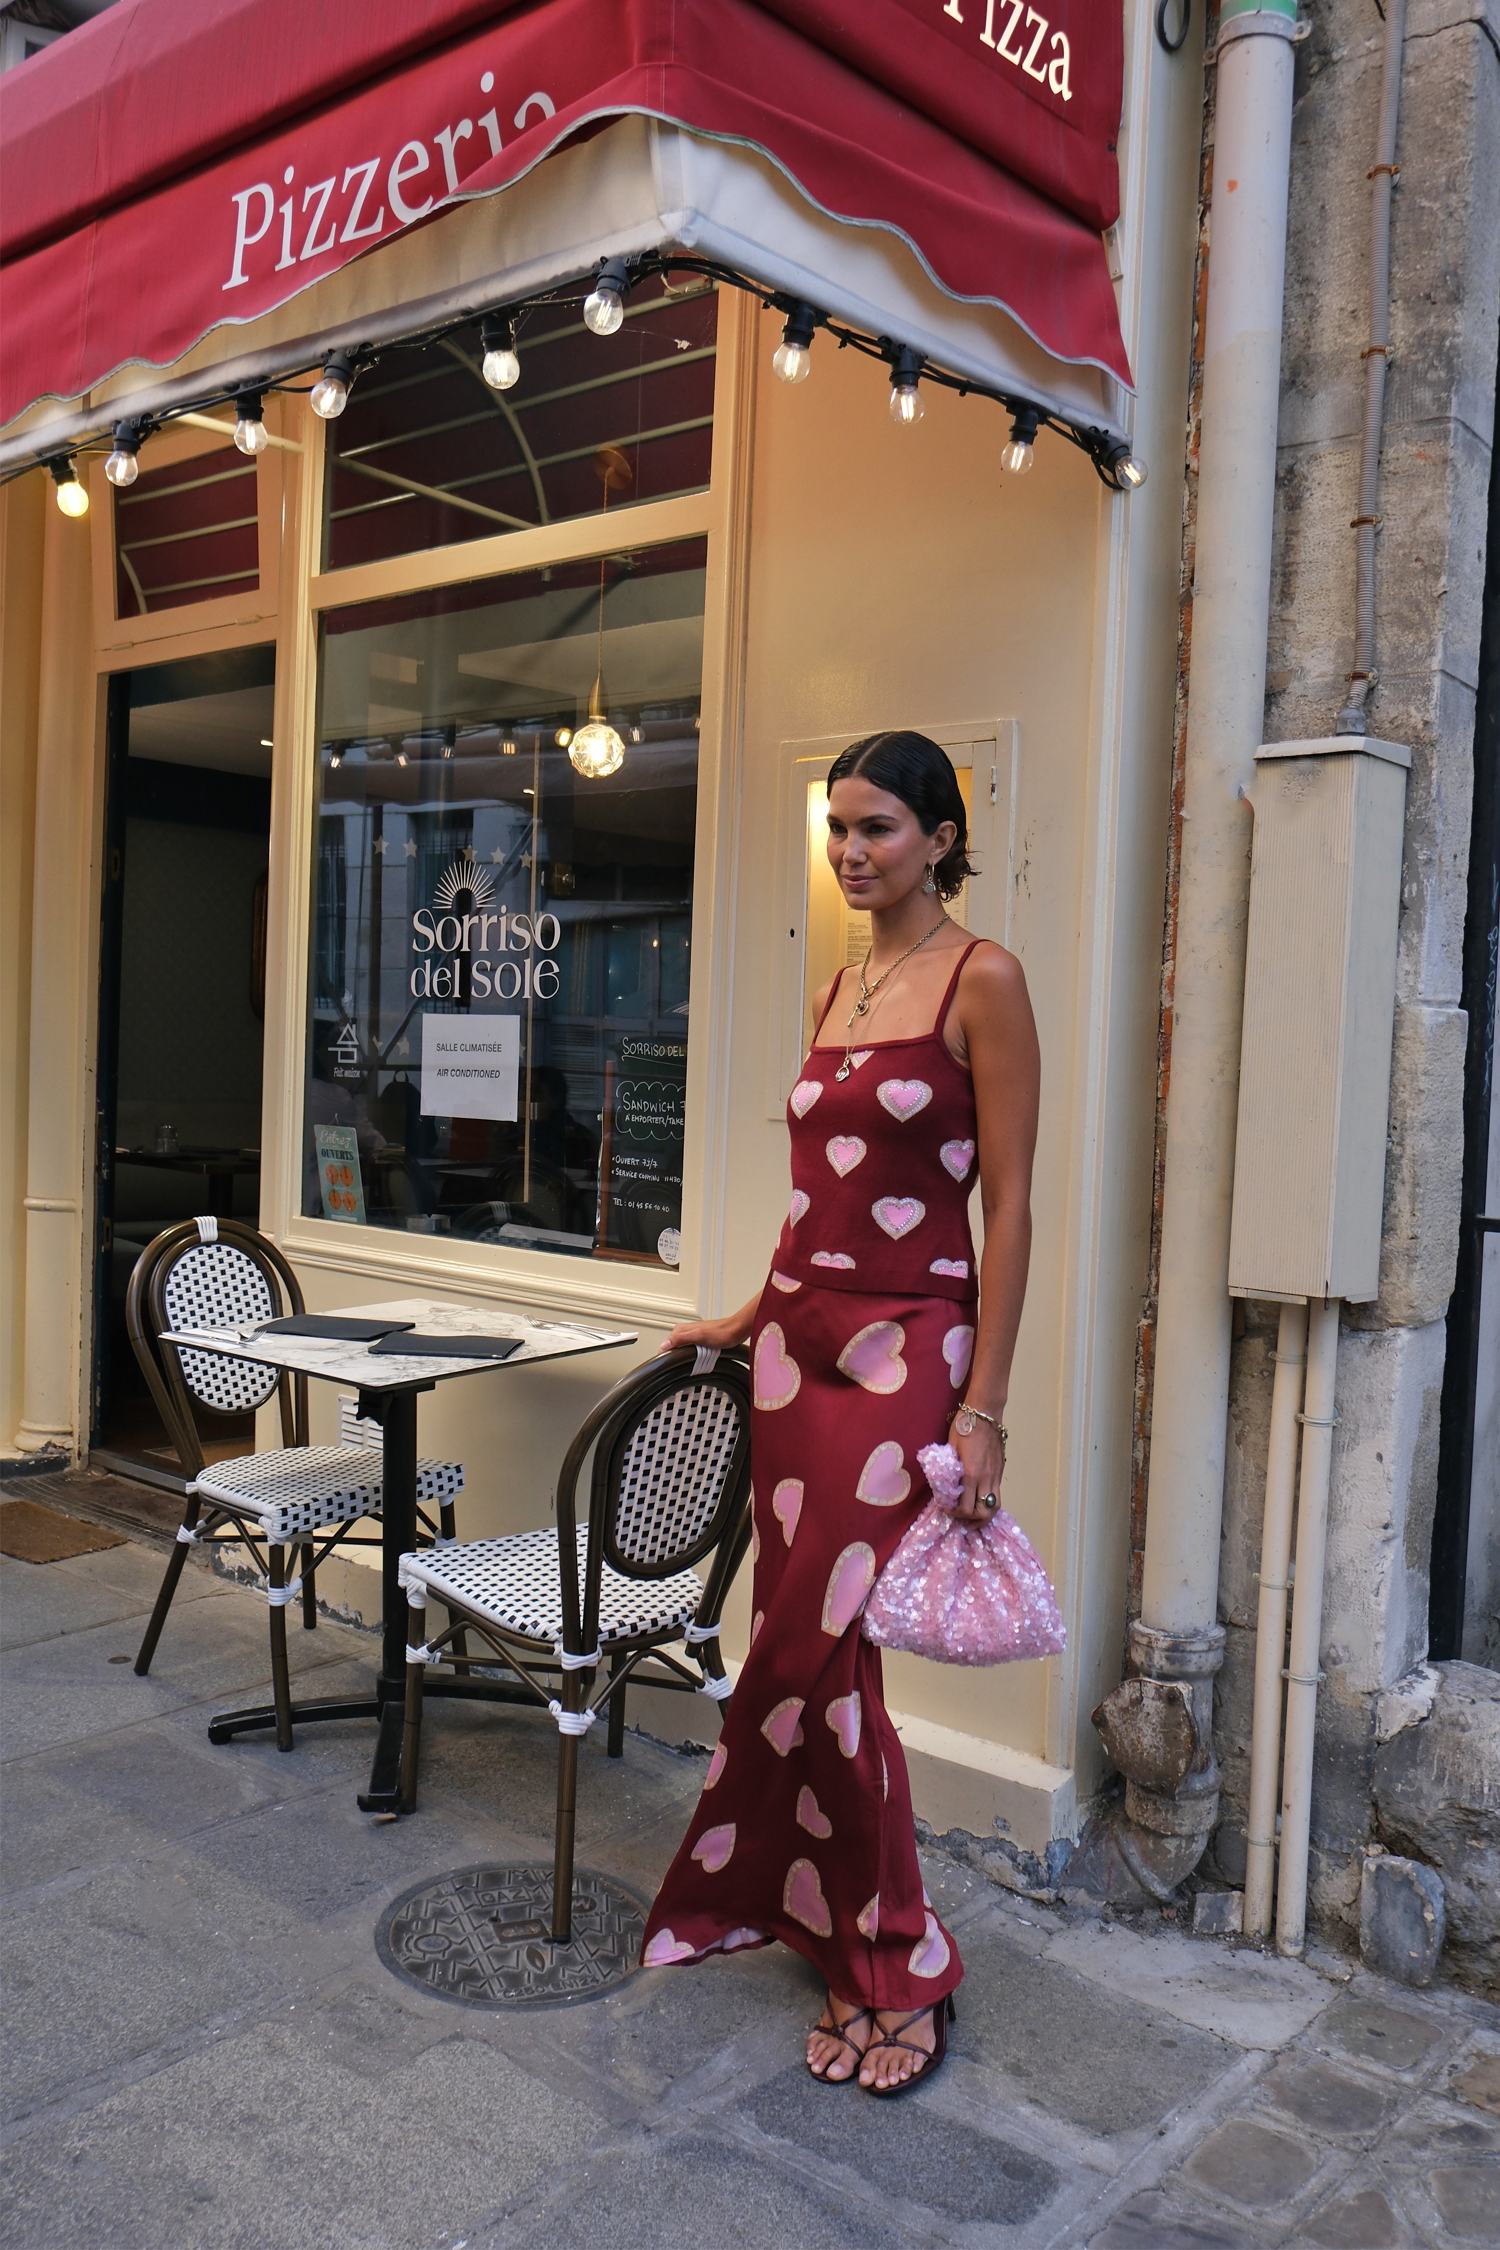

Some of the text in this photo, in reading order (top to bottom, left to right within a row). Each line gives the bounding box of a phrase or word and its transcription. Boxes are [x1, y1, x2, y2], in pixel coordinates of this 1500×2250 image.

[412, 904, 561, 953] Sorriso
[410, 958, 462, 998] del
[436, 1041, 502, 1053] SALLE CLIMATISÉE
[667, 1045, 685, 1057] DEL
[436, 1068, 501, 1079] AIR CONDITIONED
[320, 1129, 352, 1149] Entrez
[321, 1148, 354, 1161] OUVERTS
[615, 1154, 640, 1166] OUVERT
[628, 1201, 635, 1209] 01
